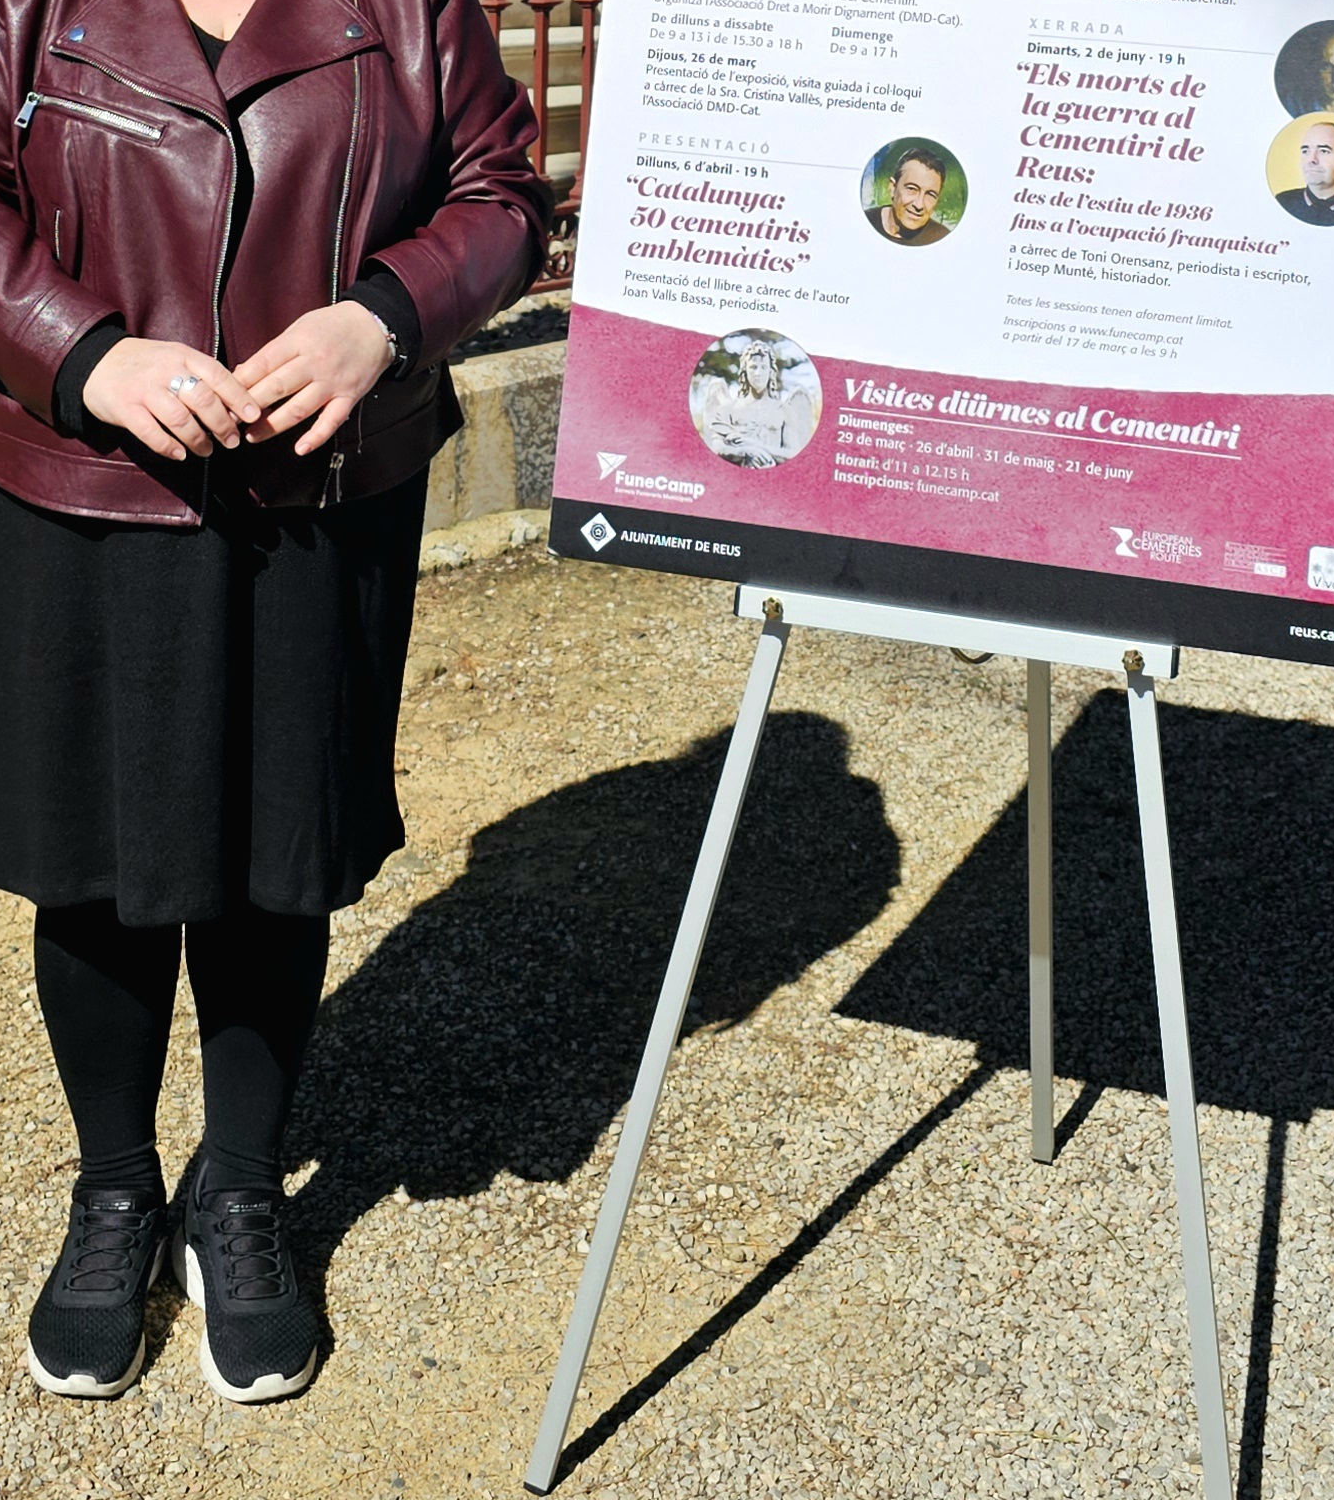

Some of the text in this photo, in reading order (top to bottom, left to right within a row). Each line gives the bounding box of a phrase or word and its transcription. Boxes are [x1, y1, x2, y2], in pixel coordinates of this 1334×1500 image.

[767, 0, 789, 12] Dret
[792, 4, 799, 12] a
[802, 3, 831, 15] Morir
[834, 5, 894, 20] Dignament
[898, 10, 962, 28] (DMD-Cat).
[1029, 17, 1123, 35] XERRADA
[831, 26, 893, 44] Diumenge
[647, 48, 756, 69] Dijous, 26 de març
[1027, 42, 1184, 65] Dimarts, 2 de juny 19 h
[645, 63, 708, 79] Presentació
[711, 69, 725, 80] de
[792, 76, 821, 89] visita
[823, 79, 862, 93] guiada
[866, 82, 870, 93] i
[1076, 72, 1164, 94] morts
[1169, 74, 1206, 98] de
[1021, 92, 1195, 129] la guerra al
[638, 132, 769, 154] PRESENTACIÓ
[1020, 125, 1204, 161] Cementiri de
[636, 155, 679, 170] Dilluns,
[683, 160, 690, 170] 6
[744, 166, 757, 177] 19
[761, 166, 768, 178] h
[1015, 156, 1095, 183] Reus:
[1013, 187, 1046, 204] des
[1049, 191, 1073, 207] de
[1137, 199, 1161, 216] de
[1164, 202, 1213, 221] 1936
[629, 206, 810, 242] 50 cementiris
[1009, 213, 1046, 231] fins
[1050, 221, 1063, 232] a
[1008, 257, 1170, 286] i Josep Munté, historiador.
[1009, 243, 1310, 285] a càrrec de Toni Orensanz, periodista i escriptor,
[622, 285, 778, 312] Joan Valls Bassa, periodista.
[1003, 315, 1065, 331] Inscripcions
[1079, 326, 1183, 345] www.funecamp.cat
[838, 413, 913, 435] Diumenges:
[845, 378, 1240, 449] Visites diürnes al Cementiri
[837, 430, 853, 443] 29
[856, 433, 872, 446] de
[875, 437, 905, 452] març
[916, 440, 931, 453] 26
[984, 449, 998, 461] 31
[1003, 451, 1020, 465] de
[1023, 456, 1054, 472] maig
[1065, 459, 1080, 472] 21
[1085, 461, 1102, 475] de
[1103, 464, 1133, 482] juny
[615, 470, 705, 498] FuneCamp
[833, 469, 999, 501] Inscripcions: funecamp.cat
[620, 530, 740, 556] AJUNTAMENT DE REUS
[1131, 538, 1201, 557] CEMETERIES
[1141, 530, 1193, 545] EUROPEAN
[1149, 551, 1181, 563] ROUTE
